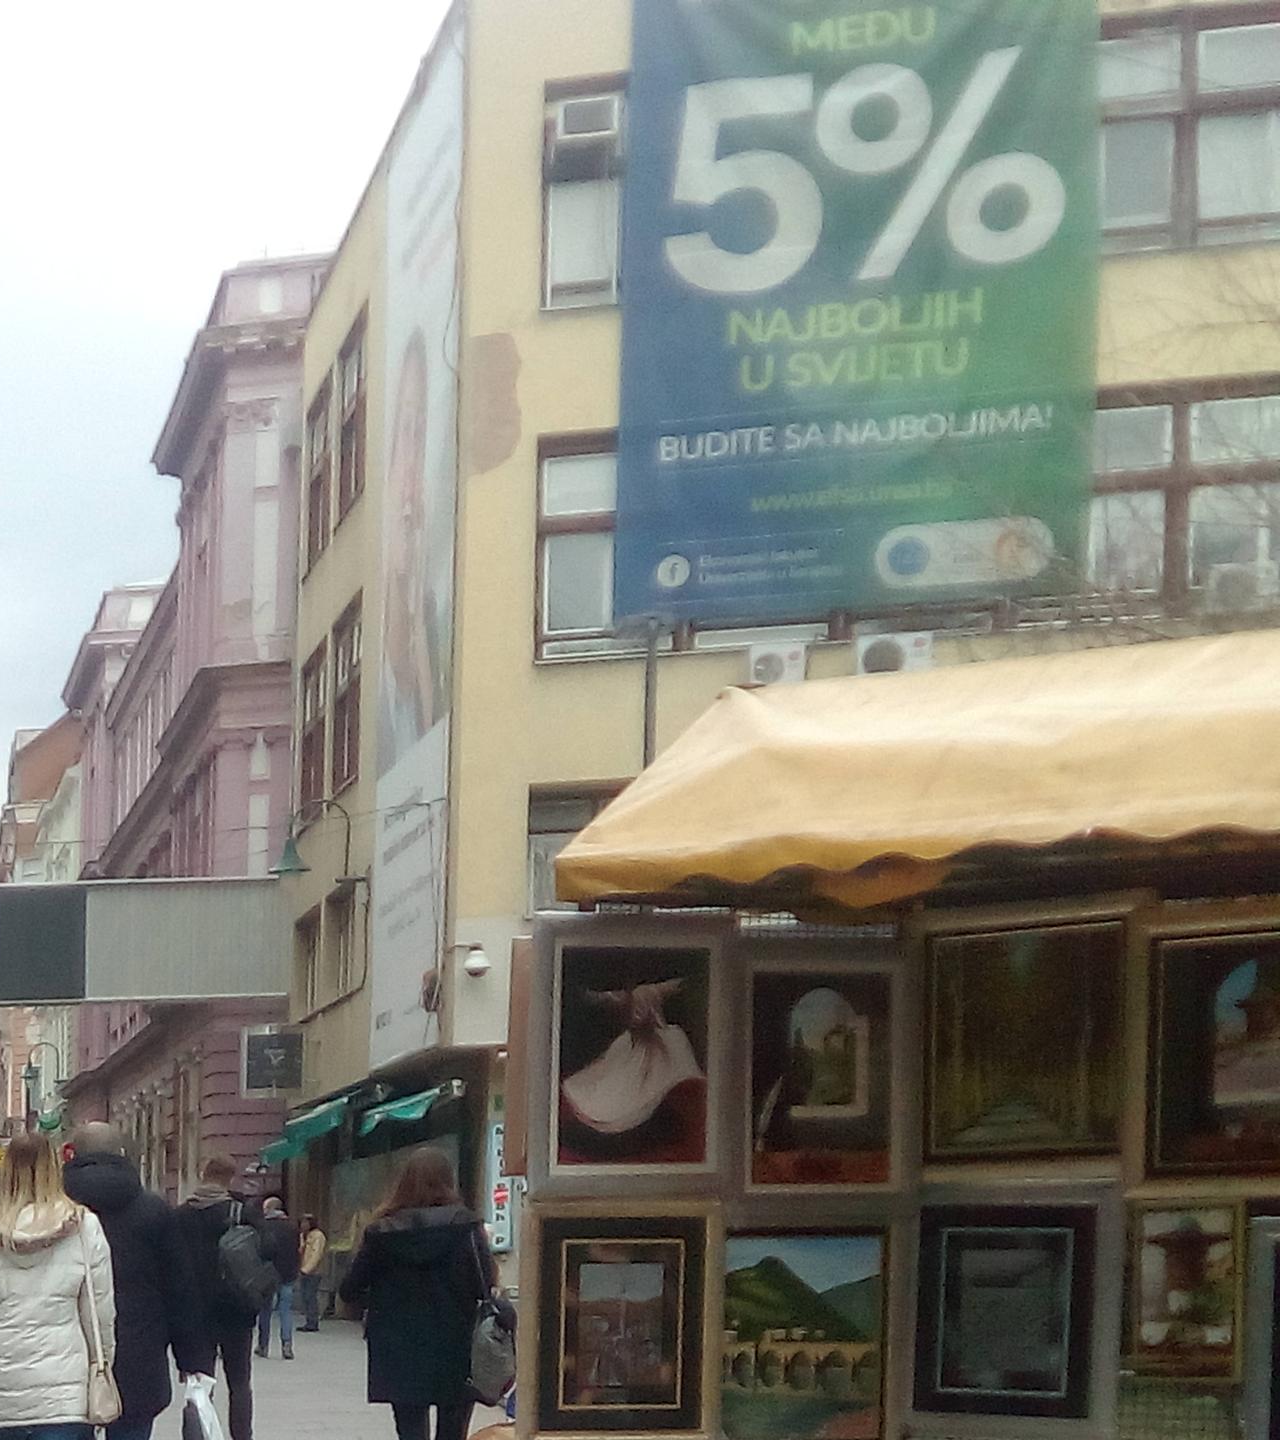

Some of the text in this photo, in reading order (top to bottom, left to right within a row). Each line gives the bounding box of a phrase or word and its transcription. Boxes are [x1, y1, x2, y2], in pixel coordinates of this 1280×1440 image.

[665, 44, 1068, 293] 5%
[728, 285, 985, 346] NAJBOLJIH
[742, 336, 970, 392] U SVIJETU
[658, 401, 1053, 463] BUDITE SA NAJBOLJIMA!
